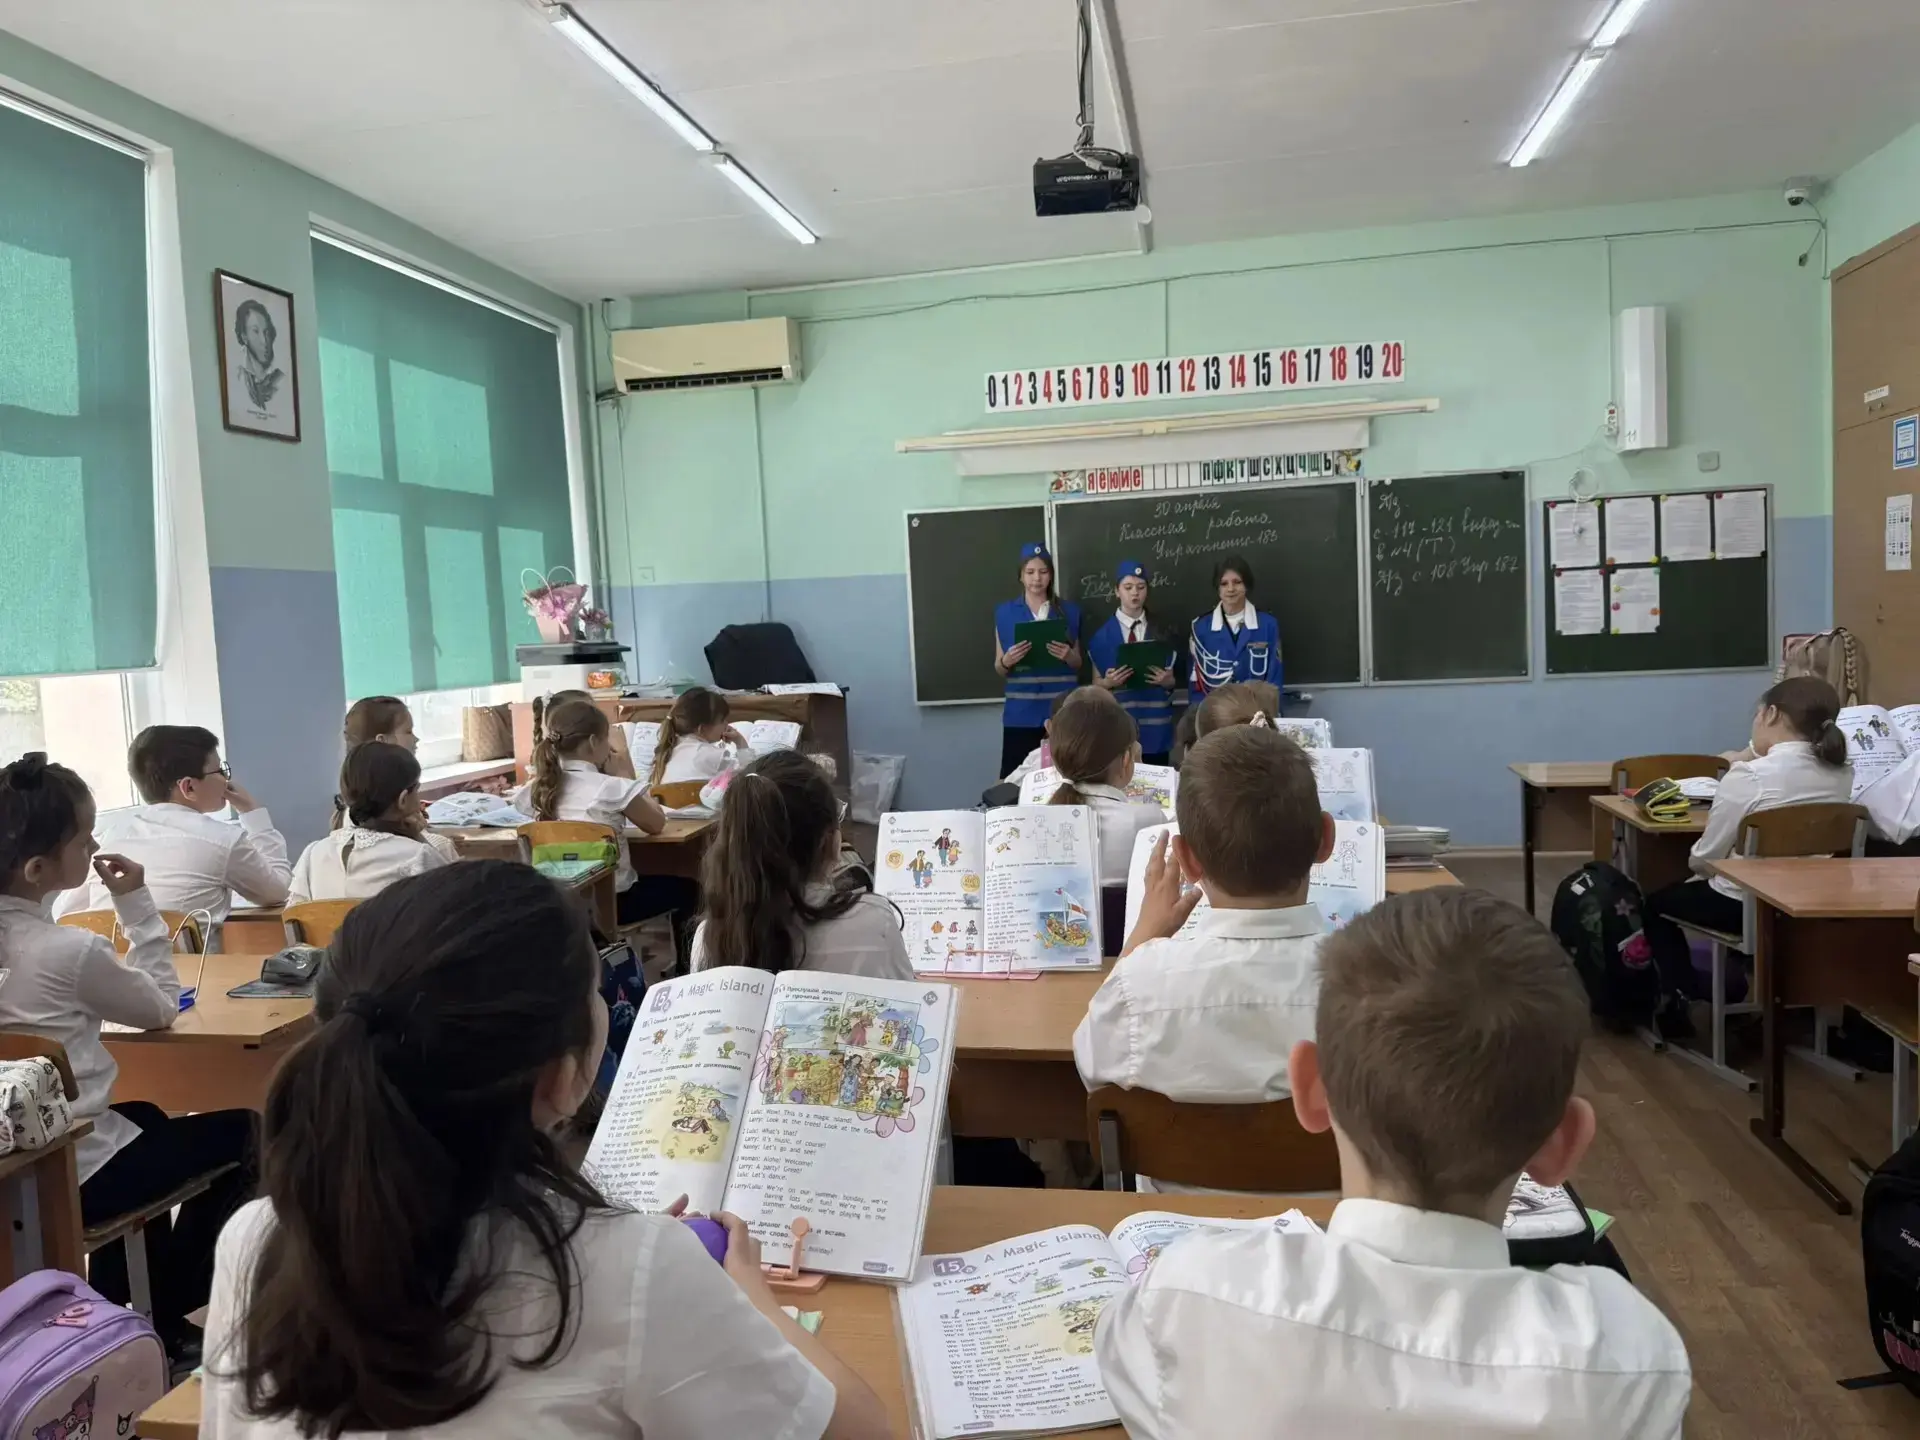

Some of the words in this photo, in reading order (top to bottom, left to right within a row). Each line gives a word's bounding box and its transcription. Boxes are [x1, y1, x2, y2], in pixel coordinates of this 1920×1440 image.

[988, 375, 997, 407] 0
[1002, 374, 1009, 406] 1
[1015, 373, 1023, 405] 2
[1029, 372, 1037, 405] 3
[1043, 371, 1052, 403] 4
[1057, 370, 1066, 402] 5
[1072, 368, 1081, 401] 6
[1087, 367, 1094, 399] 7
[1100, 365, 1108, 398] 8
[1115, 364, 1124, 397] 9
[1132, 362, 1148, 396] 10
[1157, 360, 1171, 394] 11
[1179, 358, 1196, 392] 12
[1203, 356, 1220, 390] 13
[1229, 354, 1246, 388] 14
[1253, 352, 1271, 386] 15
[1280, 350, 1297, 384] 16
[1305, 348, 1321, 382] 17
[1330, 346, 1346, 380] 18
[1356, 344, 1373, 379] 19
[1382, 342, 1401, 377] 20
[1154, 501, 1169, 517] 30
[1119, 522, 1187, 542] Классная
[677, 988, 684, 999] A
[688, 982, 715, 996] Magic
[720, 978, 764, 995] Island!
[735, 1050, 751, 1059] spring
[839, 1202, 856, 1210] We're
[840, 1211, 861, 1220] playing
[936, 1261, 959, 1274] 15
[984, 1254, 995, 1263] A
[1003, 1240, 1048, 1259] Magic
